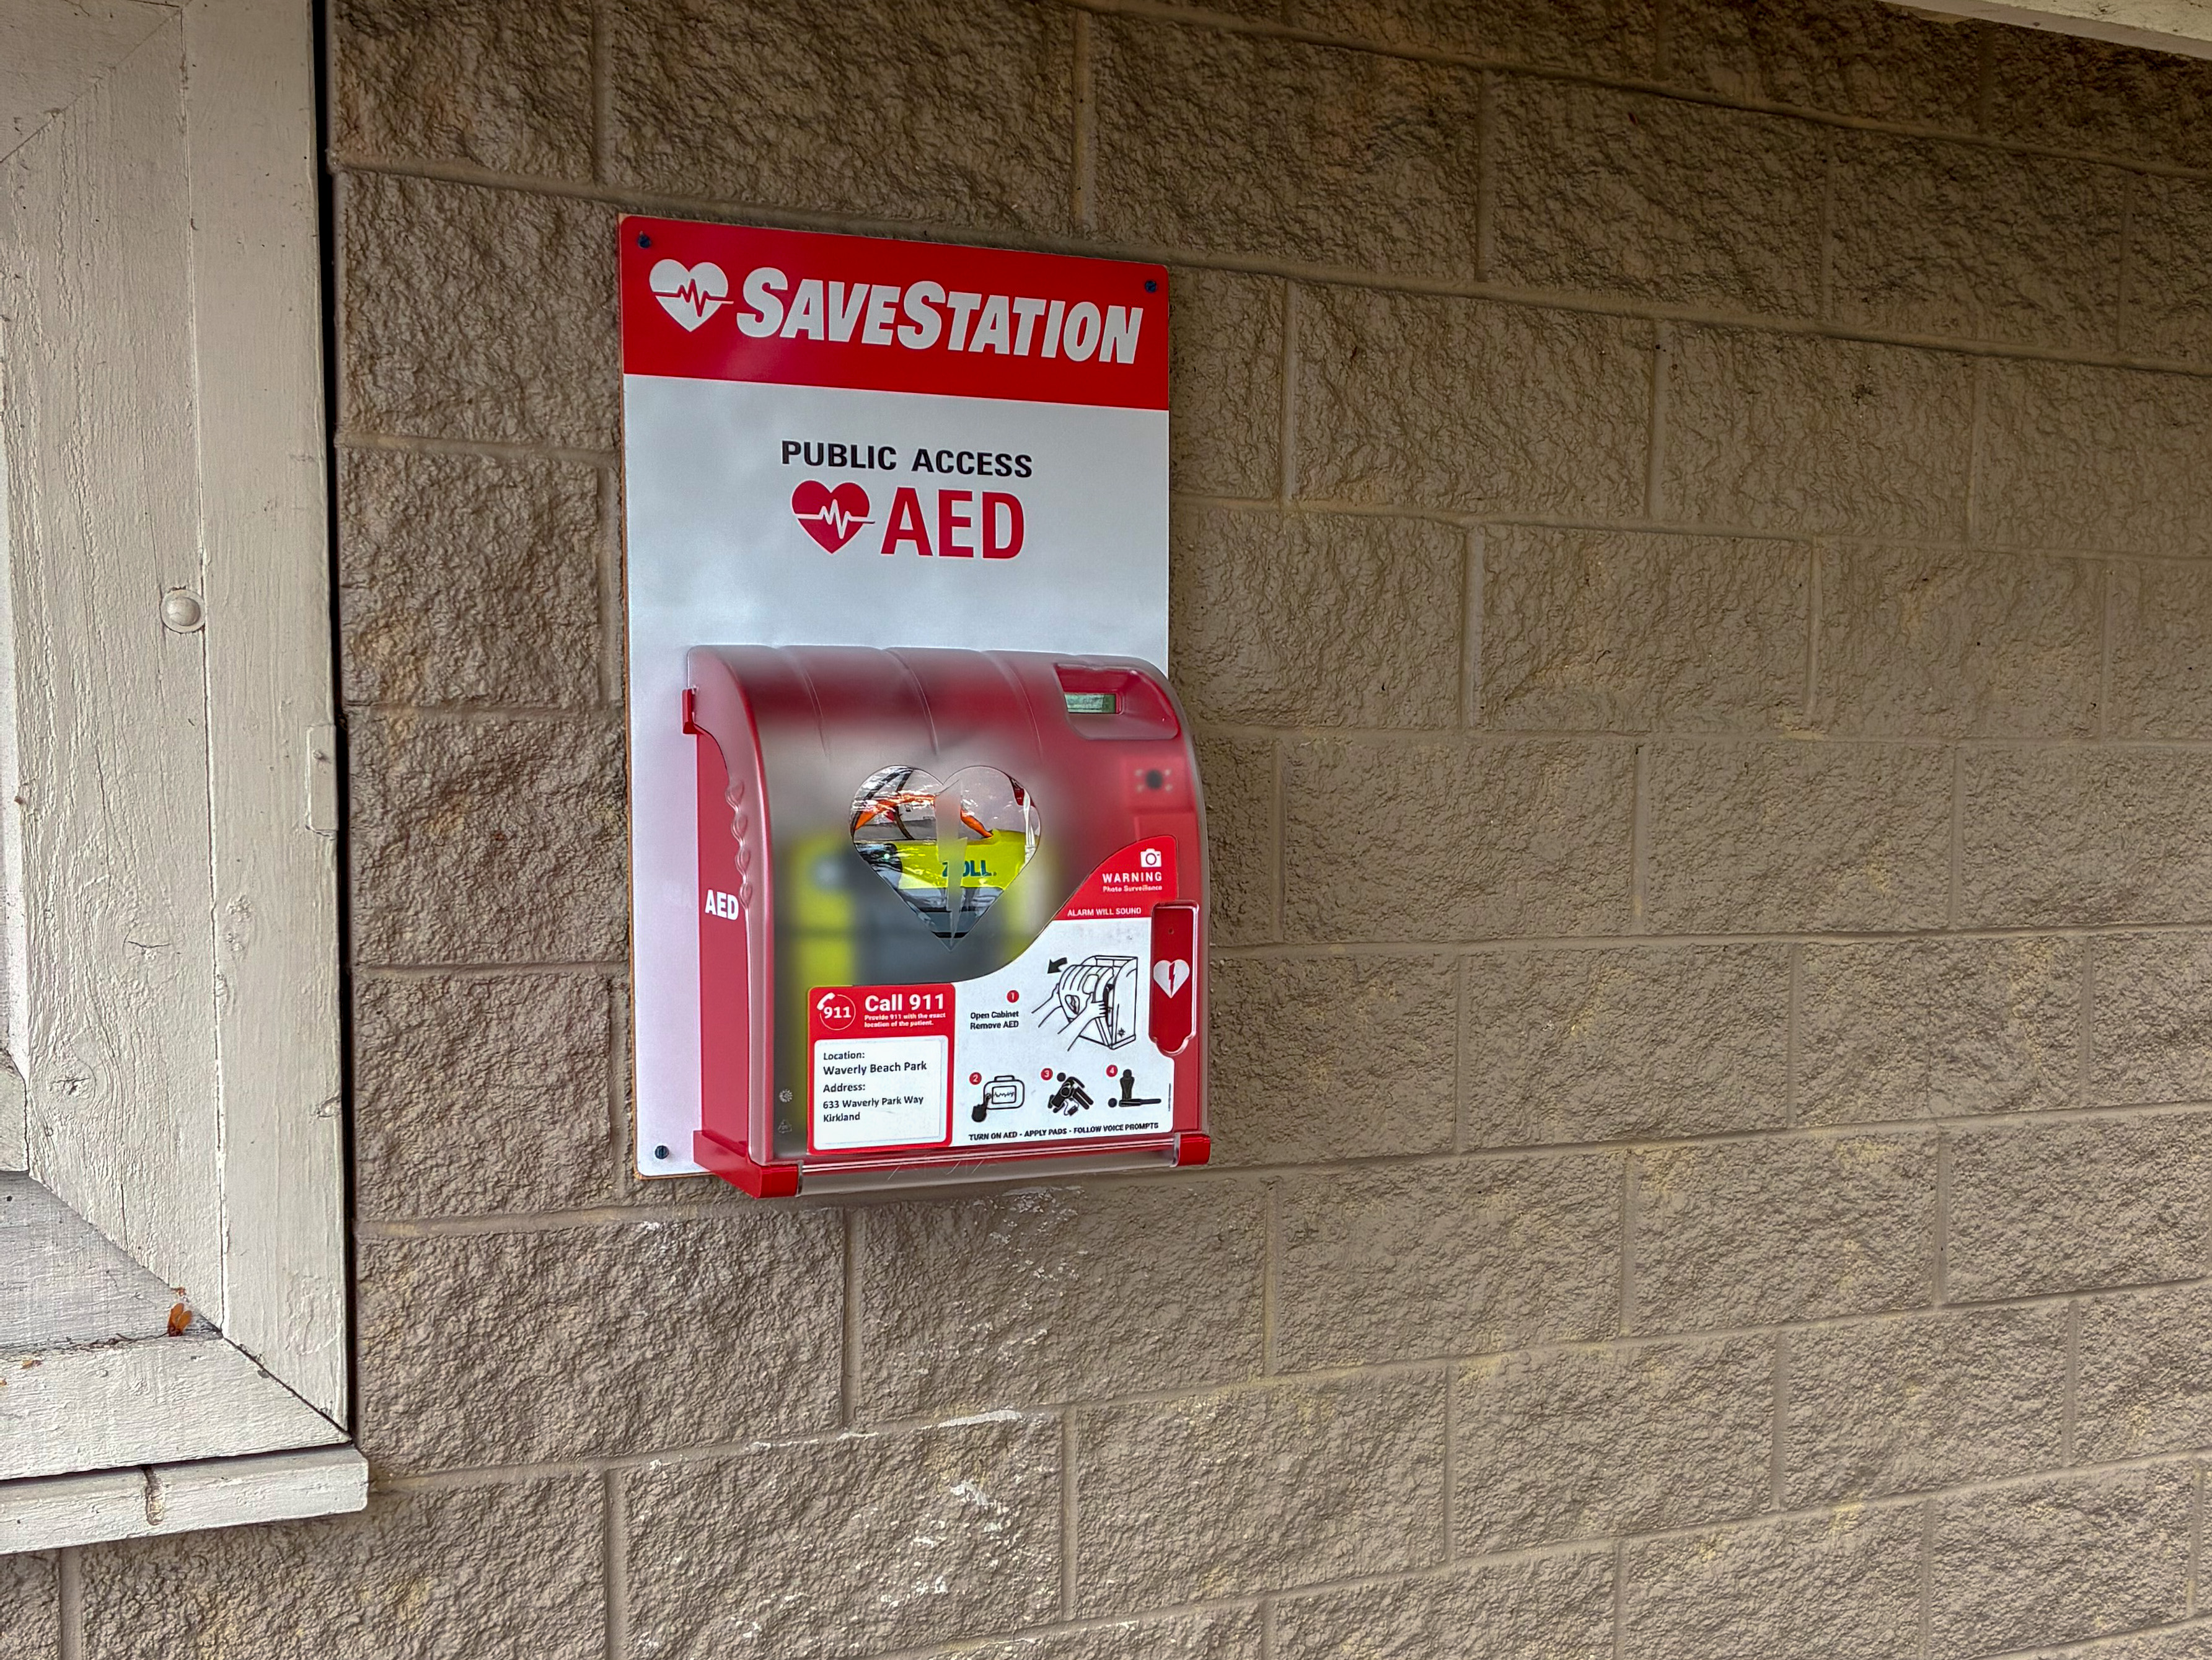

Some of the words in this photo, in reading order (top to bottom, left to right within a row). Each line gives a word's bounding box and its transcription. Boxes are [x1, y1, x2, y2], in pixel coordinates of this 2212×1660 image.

[737, 267, 1143, 364] SAVESTATION
[782, 440, 897, 471] PUBLIC
[911, 447, 1033, 478] ACCESS
[880, 486, 1025, 560] AED
[1102, 872, 1162, 883] WARNING
[705, 889, 739, 921] AED
[1067, 908, 1094, 916] ALARM
[865, 993, 902, 1012] Call
[909, 993, 944, 1011] 911
[824, 1006, 851, 1019] 911
[970, 1012, 990, 1021] Open
[992, 1010, 1019, 1018] Cabinet
[910, 1020, 934, 1028] patient.
[823, 1051, 865, 1060] Location:
[823, 1064, 866, 1075] Waverly
[870, 1062, 901, 1073] Beach
[904, 1061, 927, 1071] Park
[823, 1083, 866, 1093] Address:
[823, 1100, 839, 1109] 633
[842, 1098, 879, 1108] Waverly
[882, 1096, 902, 1105] Park
[904, 1096, 923, 1105] Way
[823, 1112, 860, 1122] Kirkland
[1073, 1126, 1102, 1134] FOLLOW
[1103, 1124, 1123, 1132] VOICE
[1125, 1122, 1159, 1130] PROMPTS
